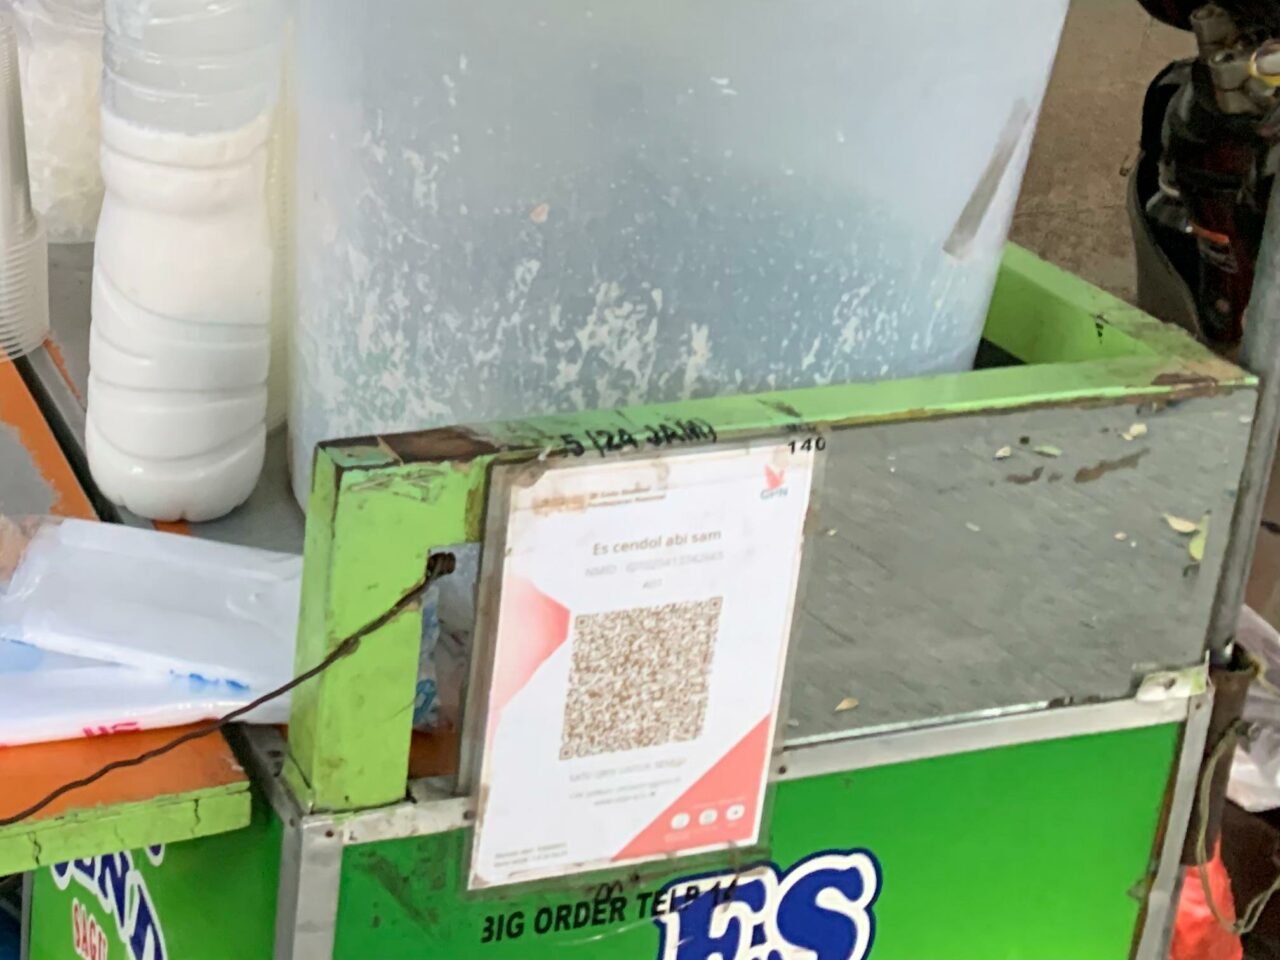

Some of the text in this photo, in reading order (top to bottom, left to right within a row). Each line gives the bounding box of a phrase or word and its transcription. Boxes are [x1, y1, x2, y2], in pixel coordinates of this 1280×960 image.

[787, 436, 826, 455] 140
[592, 530, 722, 557] Es cendol abi sam
[534, 891, 627, 935] ORDER
